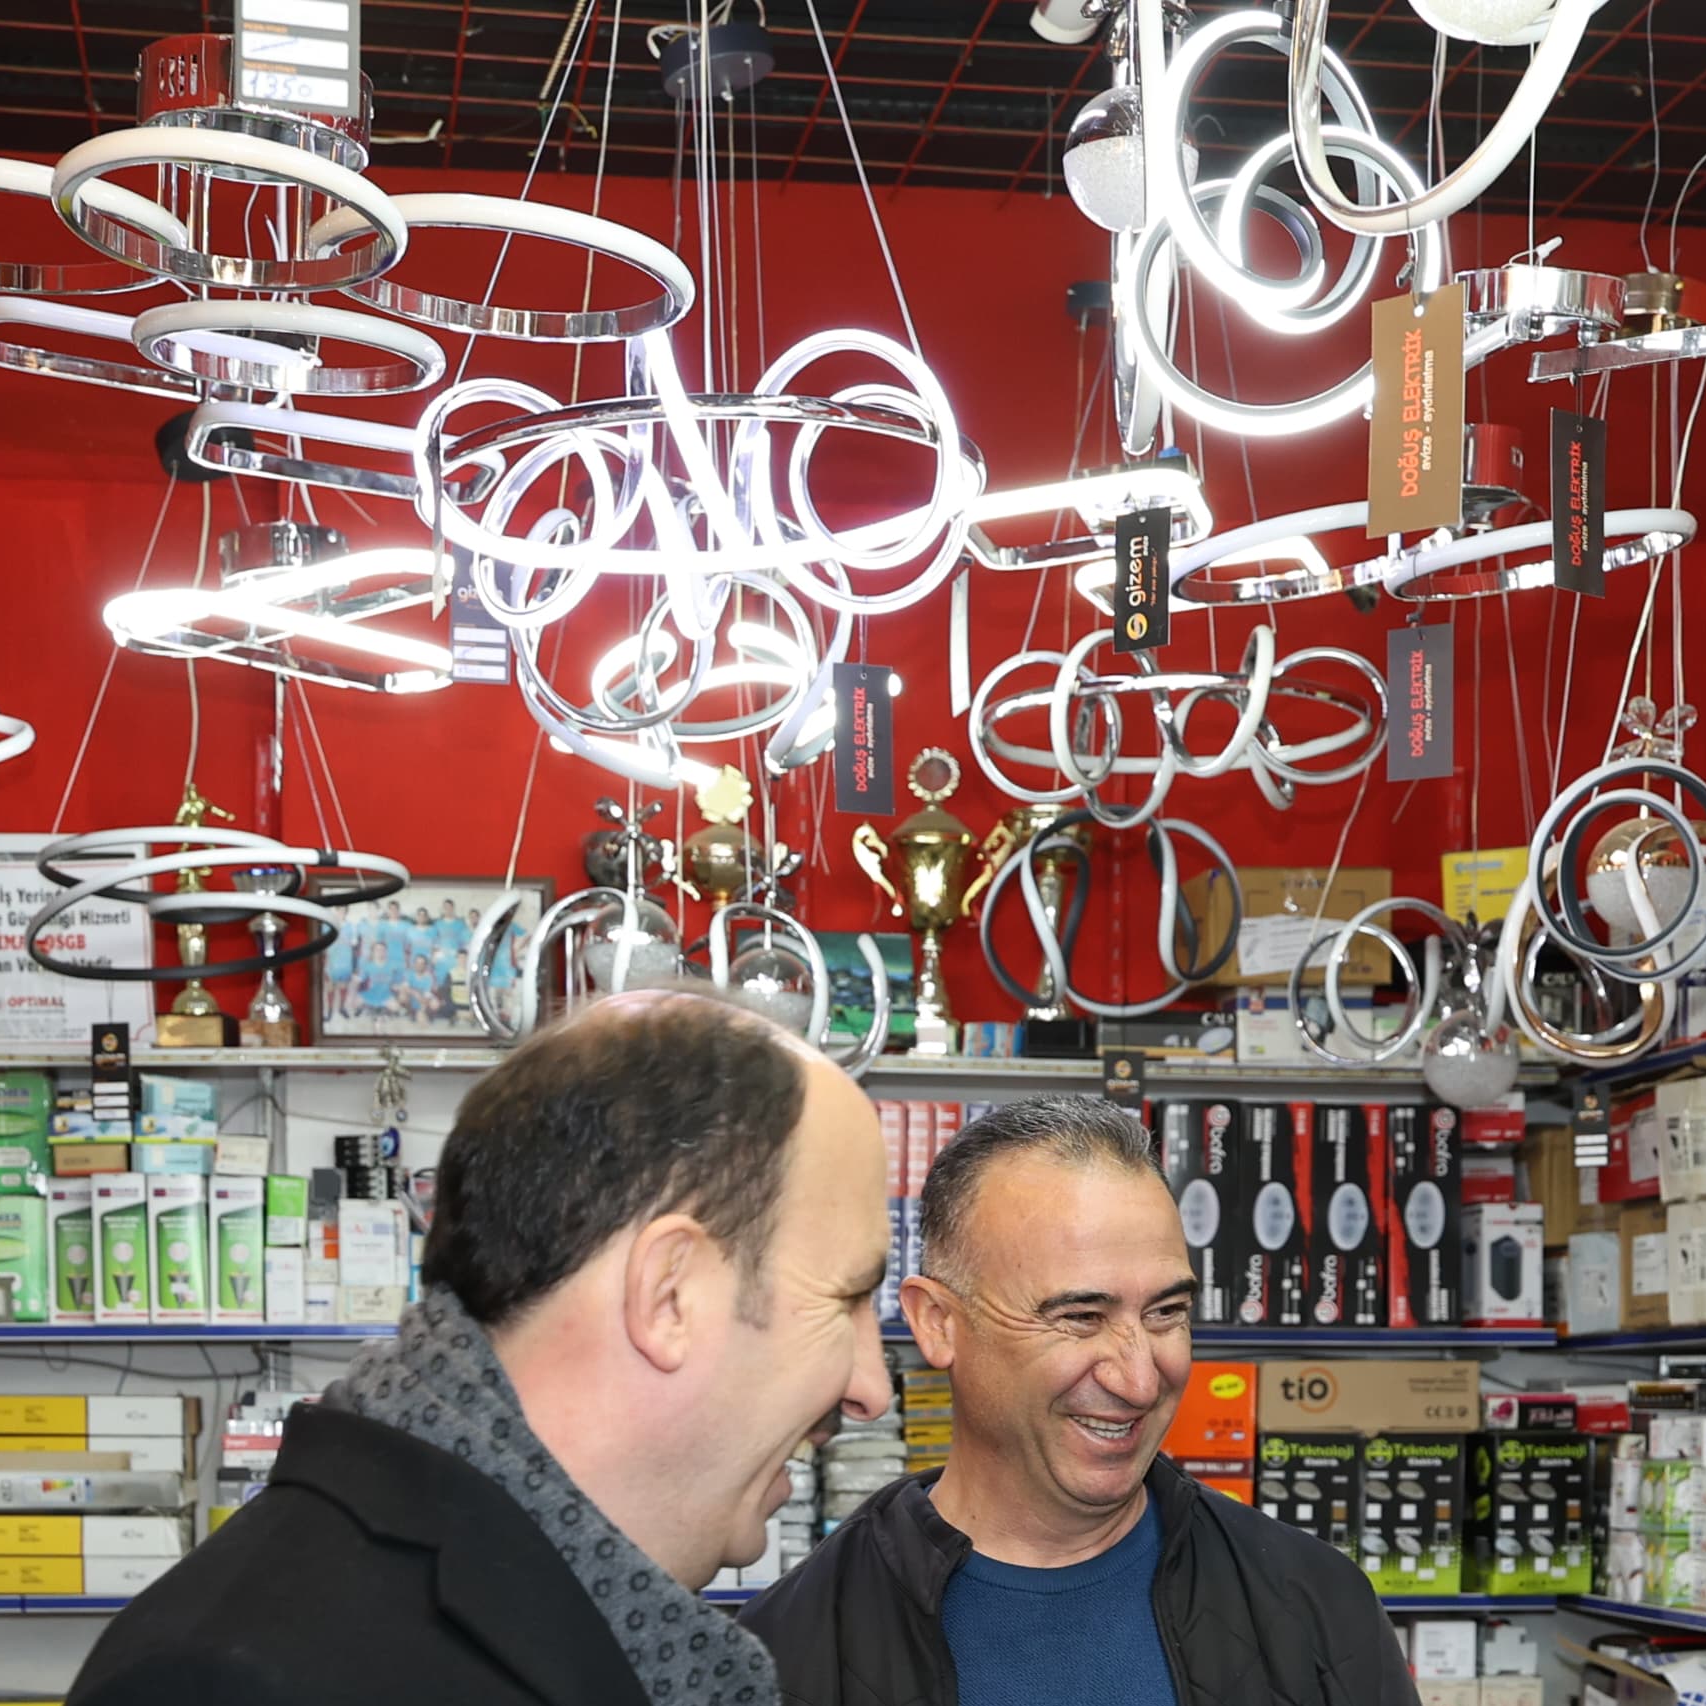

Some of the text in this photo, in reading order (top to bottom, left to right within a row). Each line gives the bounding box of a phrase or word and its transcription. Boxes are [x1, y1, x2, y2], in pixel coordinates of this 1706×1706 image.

[1398, 328, 1422, 497] DOĞUŞ ELEKTRİK
[1422, 350, 1434, 471] avize aydınlatma
[1567, 441, 1582, 566] DOĞUŞ ELEKTRİK
[1125, 536, 1146, 606] gizem
[1409, 649, 1424, 758] DOĞUŞ ELEKTRİK
[854, 686, 867, 793] DOĞUŞ ELEKTRİK
[0, 885, 11, 906] İş
[80, 911, 131, 926] Hizmeti
[1289, 1441, 1355, 1459] Teknoloji
[1393, 1441, 1458, 1459] Teknoloji
[1524, 1443, 1587, 1460] Teknoloji
